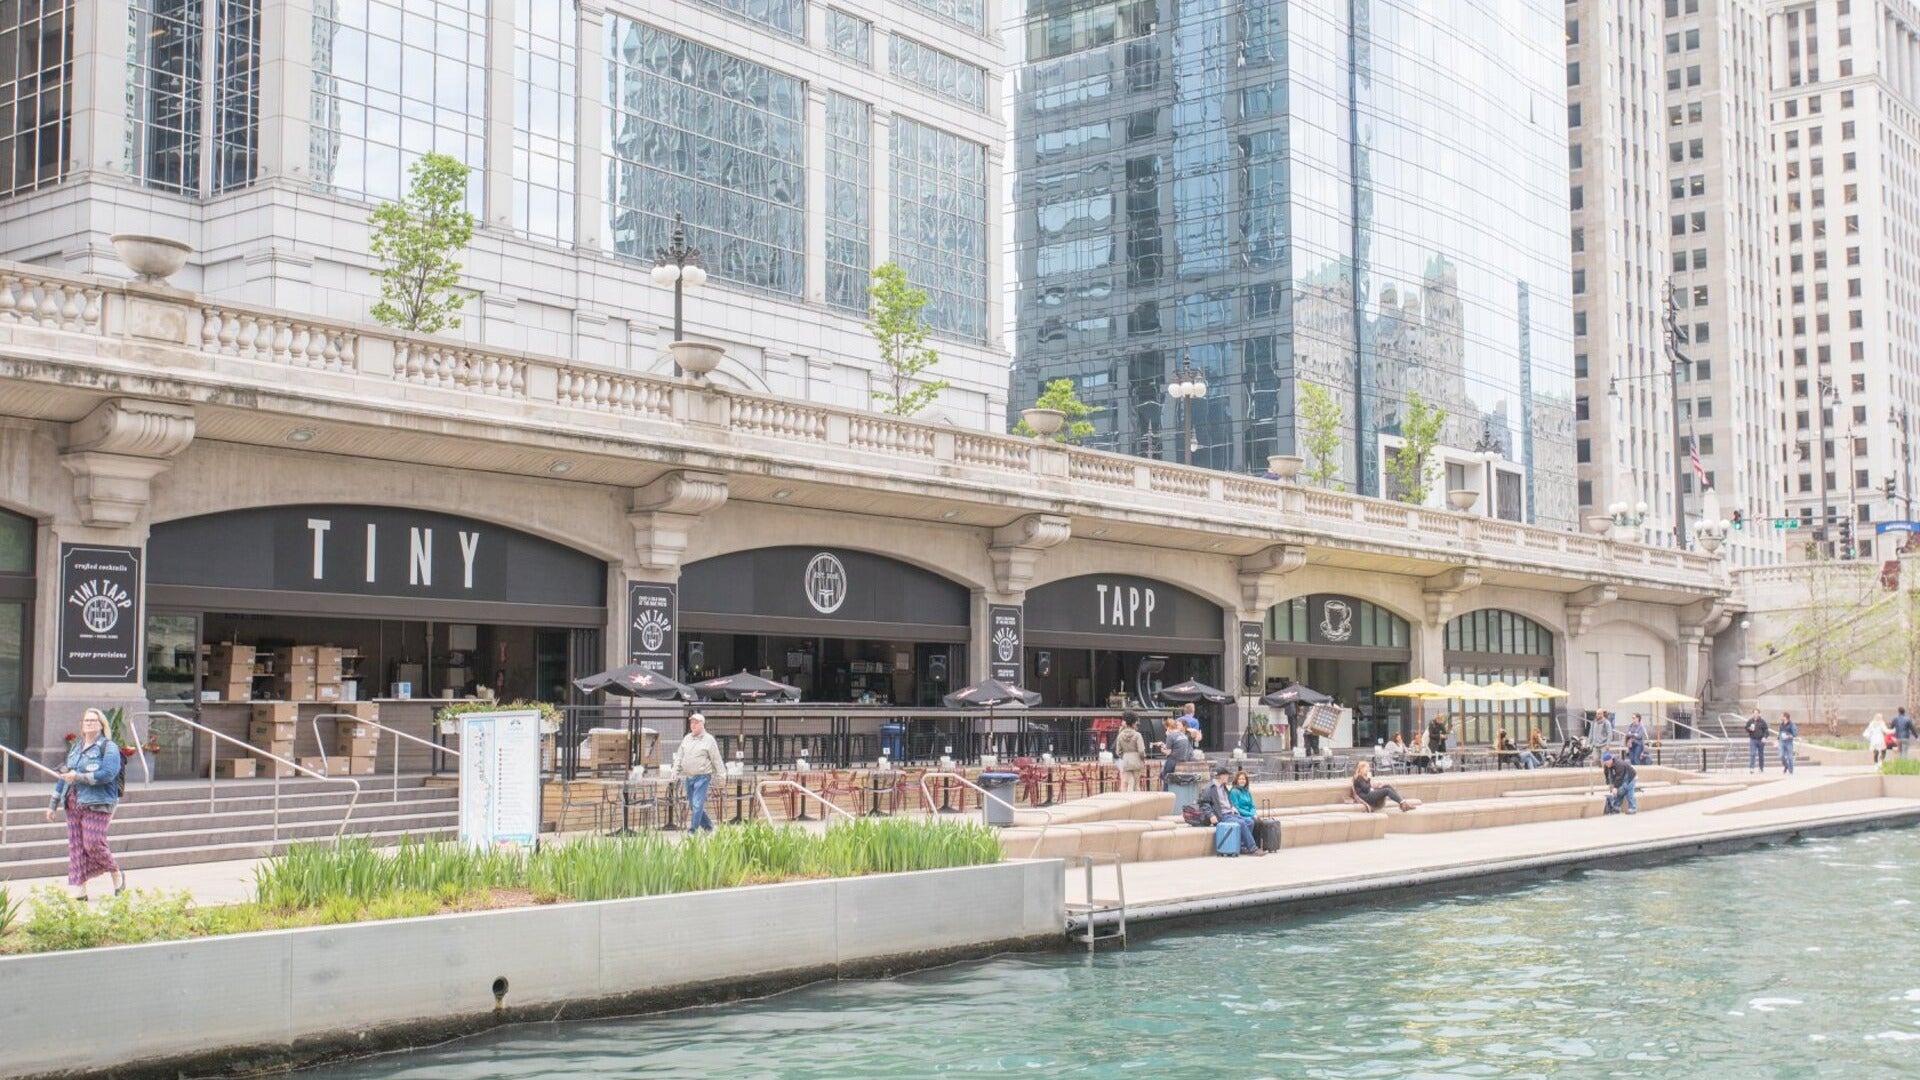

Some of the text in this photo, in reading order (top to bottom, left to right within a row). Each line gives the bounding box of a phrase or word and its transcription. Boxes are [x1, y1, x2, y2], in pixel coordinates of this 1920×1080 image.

[307, 518, 480, 588] TINY
[69, 580, 132, 609] TINY TAPP
[1096, 584, 1155, 628] TAPP
[633, 609, 671, 632] TINY TAPP
